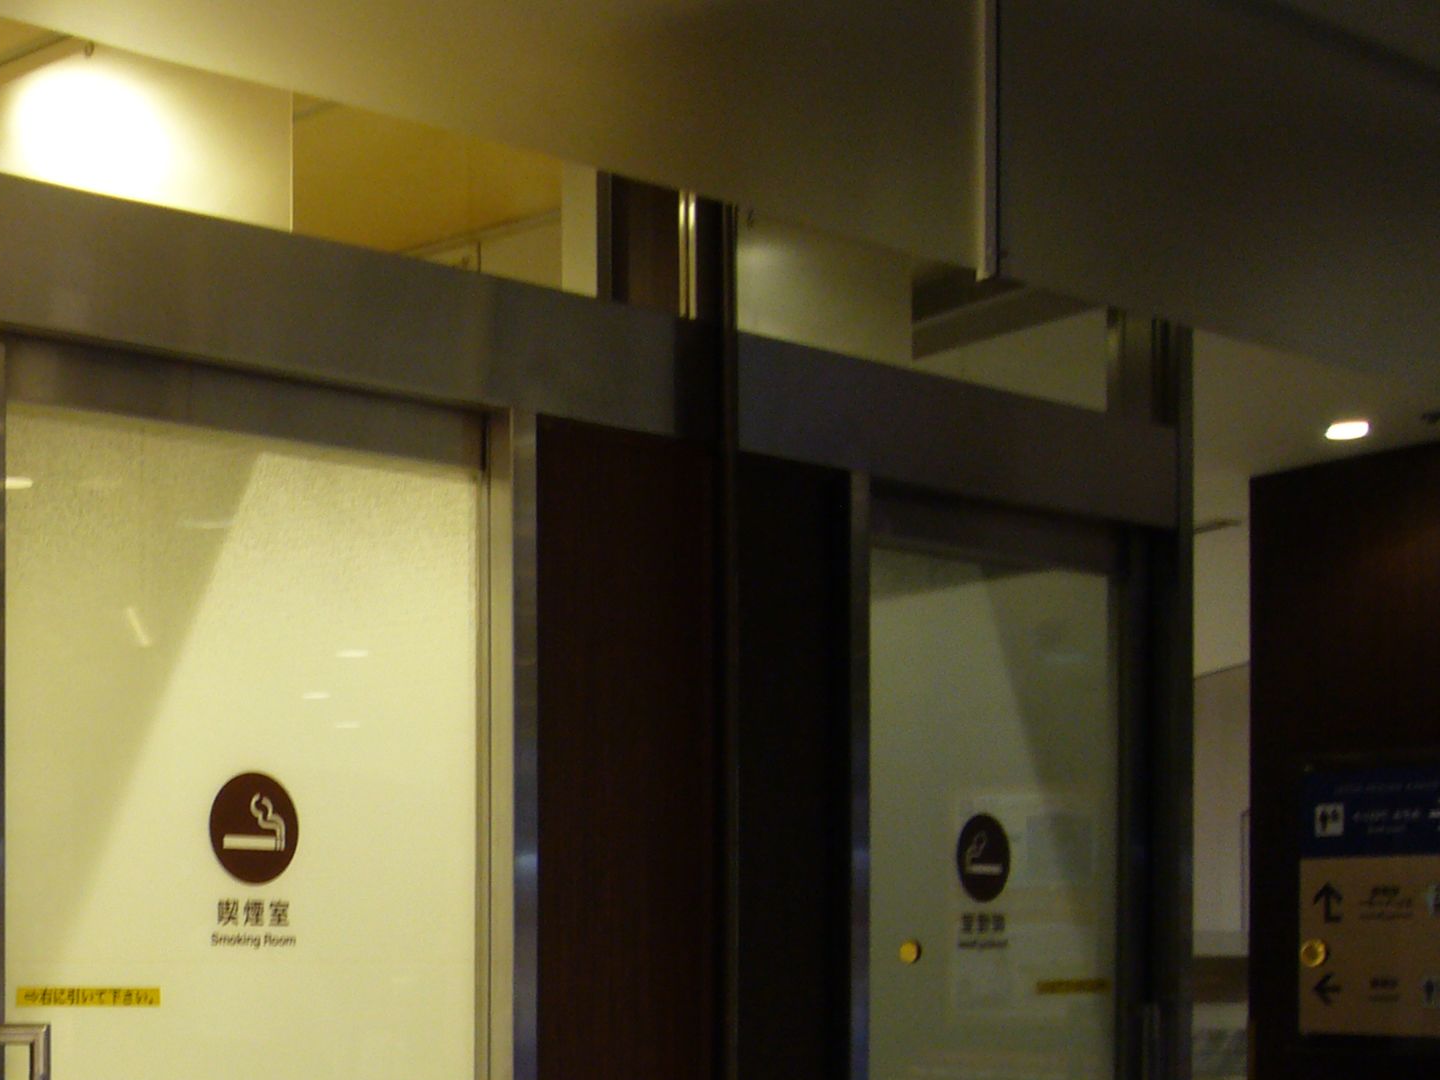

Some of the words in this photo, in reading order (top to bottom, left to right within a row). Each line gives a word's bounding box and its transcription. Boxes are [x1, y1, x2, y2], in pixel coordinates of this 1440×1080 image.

[217, 899, 290, 927] 喫煙室
[210, 932, 261, 949] Smoking
[263, 934, 296, 946] Room
